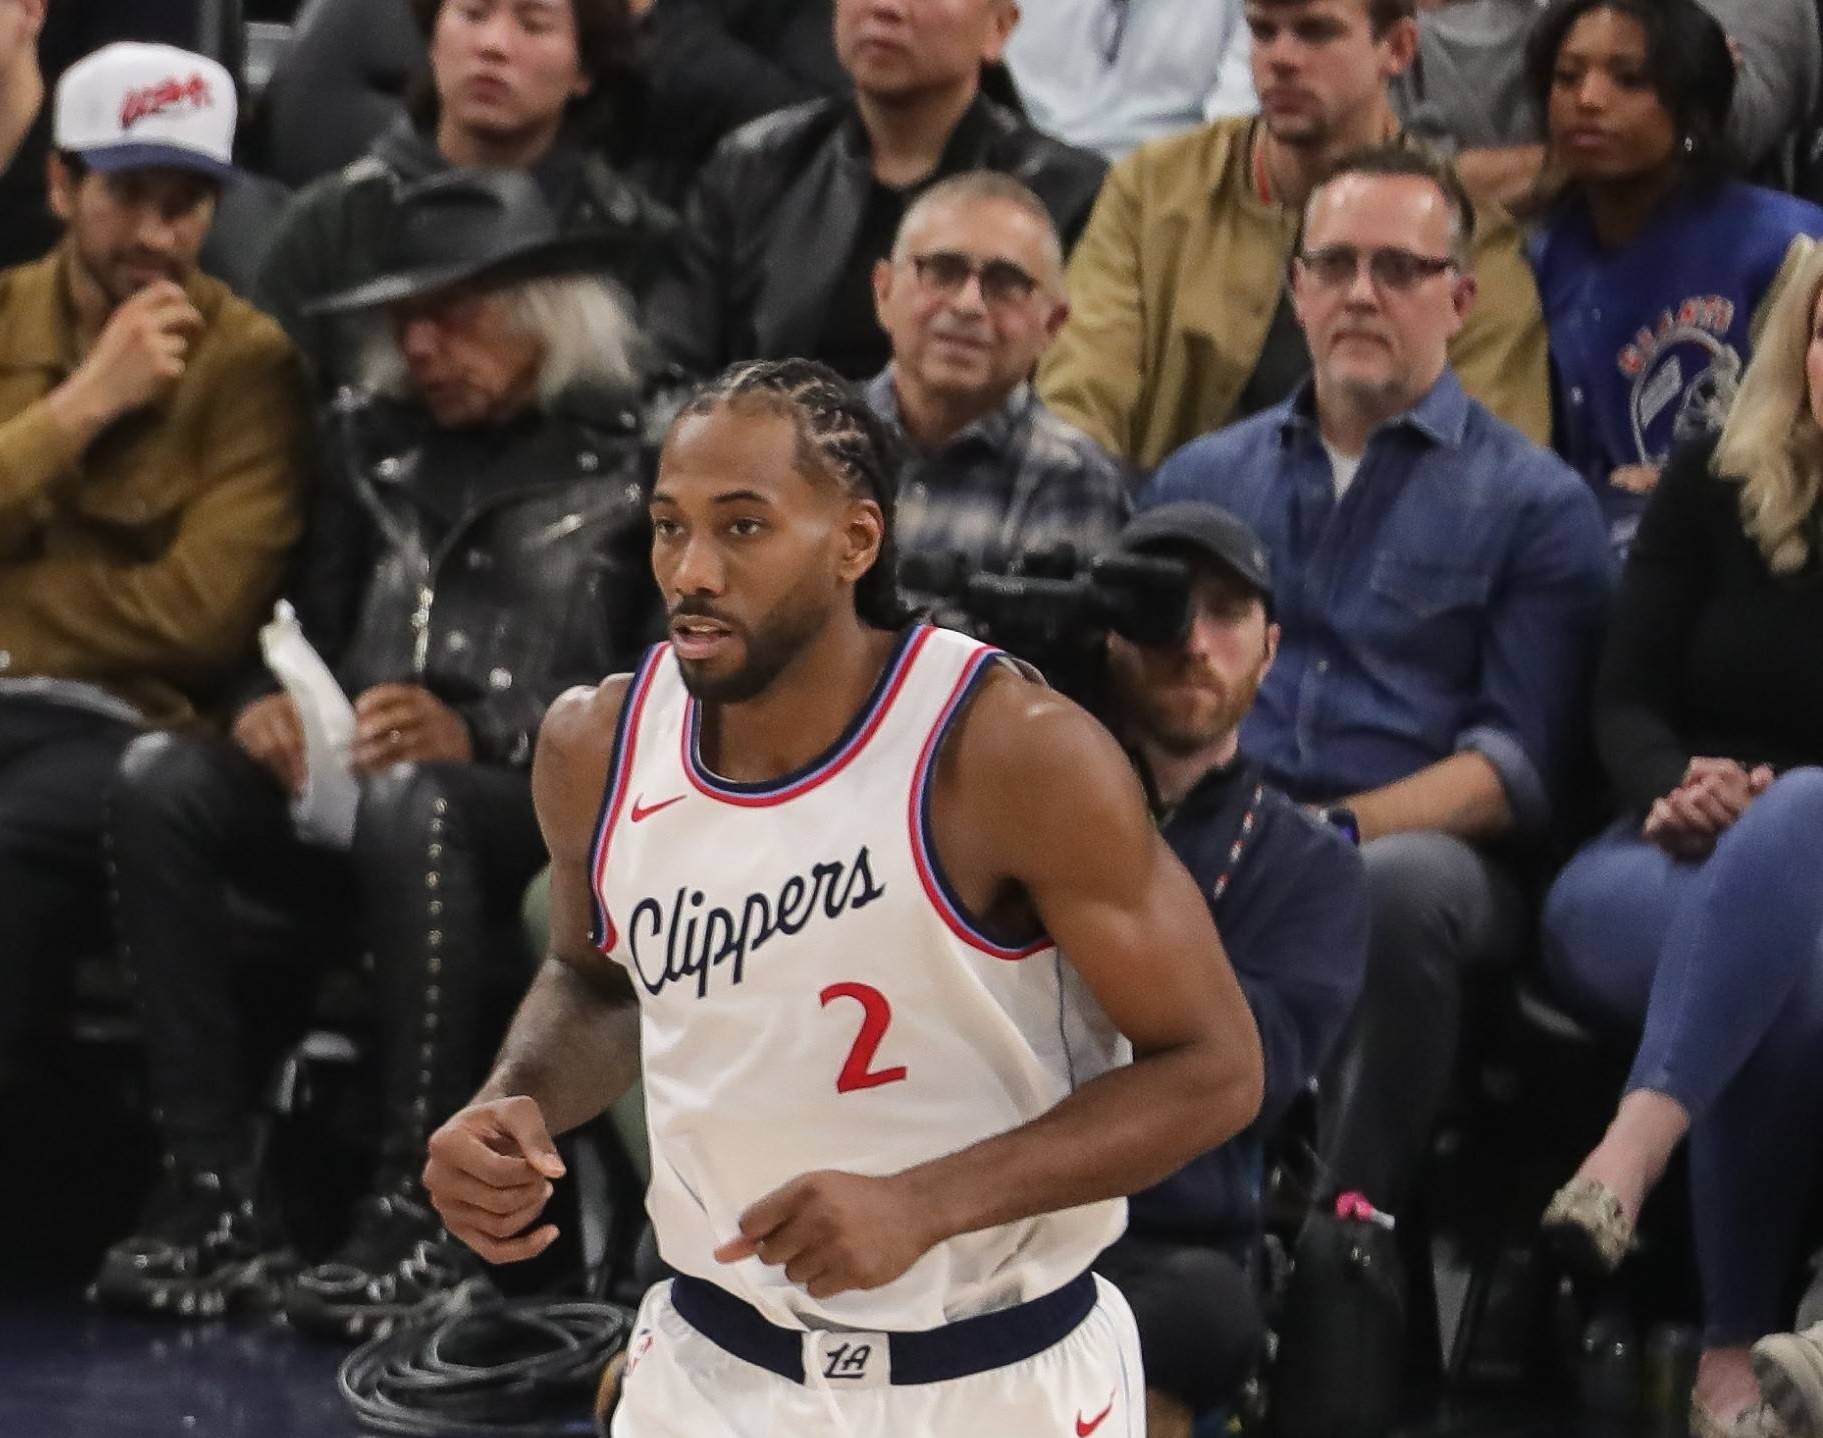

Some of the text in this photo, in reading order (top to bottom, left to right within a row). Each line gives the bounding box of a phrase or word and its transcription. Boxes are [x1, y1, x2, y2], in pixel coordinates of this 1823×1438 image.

[629, 845, 887, 998] Clippers
[820, 981, 907, 1093] 2
[823, 1342, 871, 1379] LA
